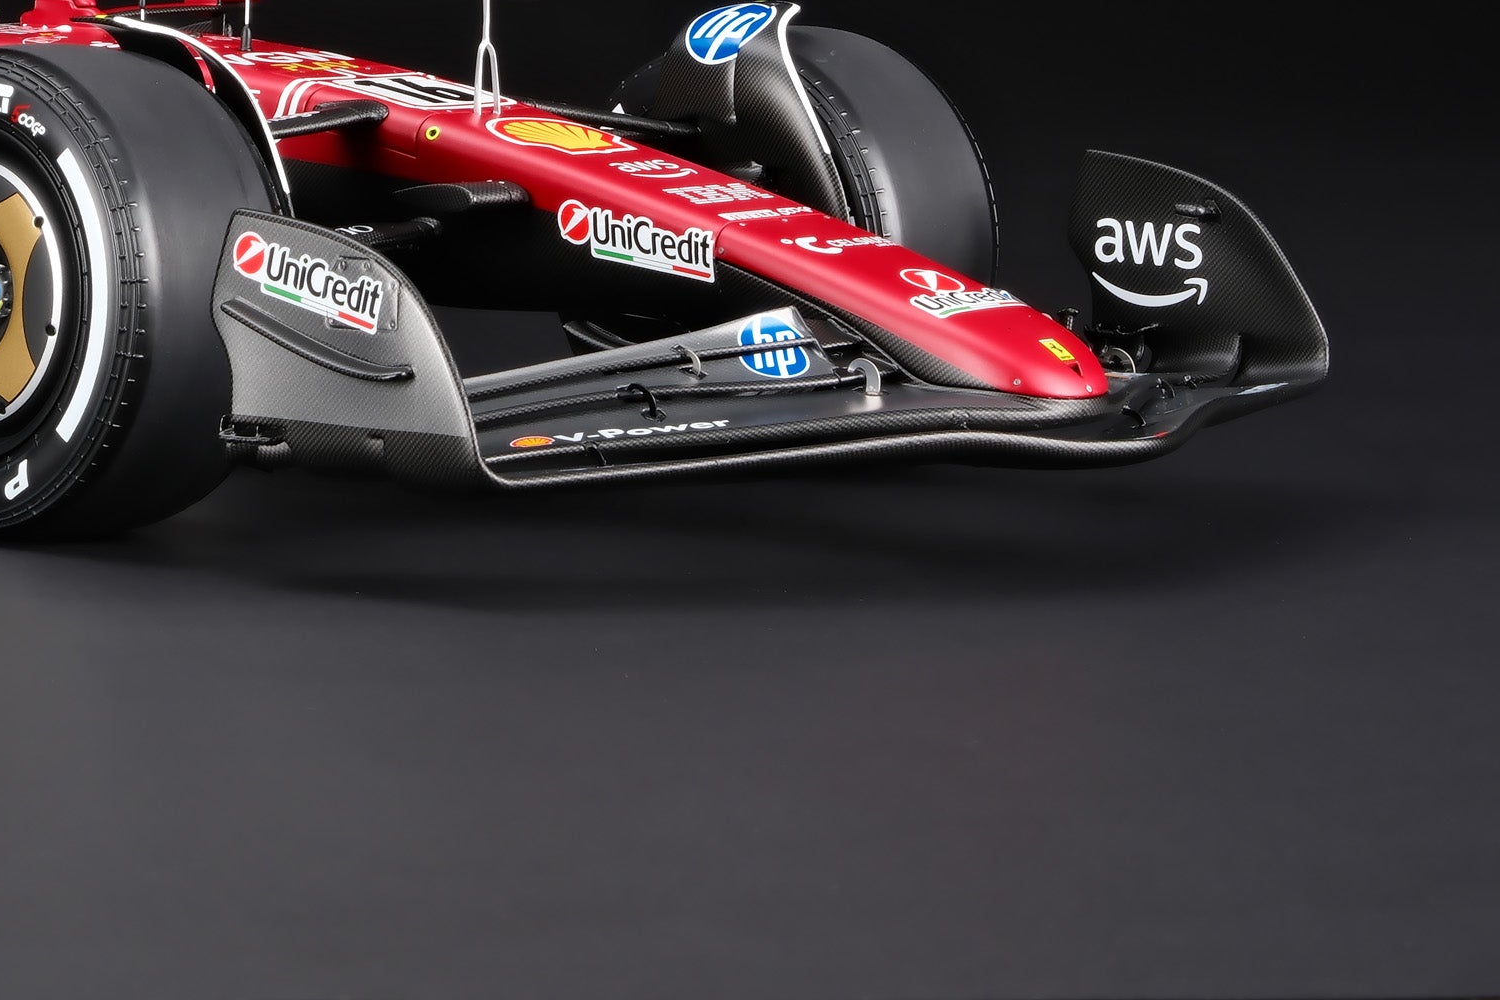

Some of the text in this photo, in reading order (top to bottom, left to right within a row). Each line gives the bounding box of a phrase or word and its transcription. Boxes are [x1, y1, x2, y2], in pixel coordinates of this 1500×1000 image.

[688, 3, 772, 64] hp
[354, 77, 475, 104] 16
[608, 158, 681, 174] aws
[592, 210, 714, 259] UniCredit
[1094, 217, 1204, 270] aws
[267, 245, 382, 320] UniCredit
[745, 314, 802, 377] hp
[554, 418, 731, 443] V-Power
[4, 458, 30, 501] P
